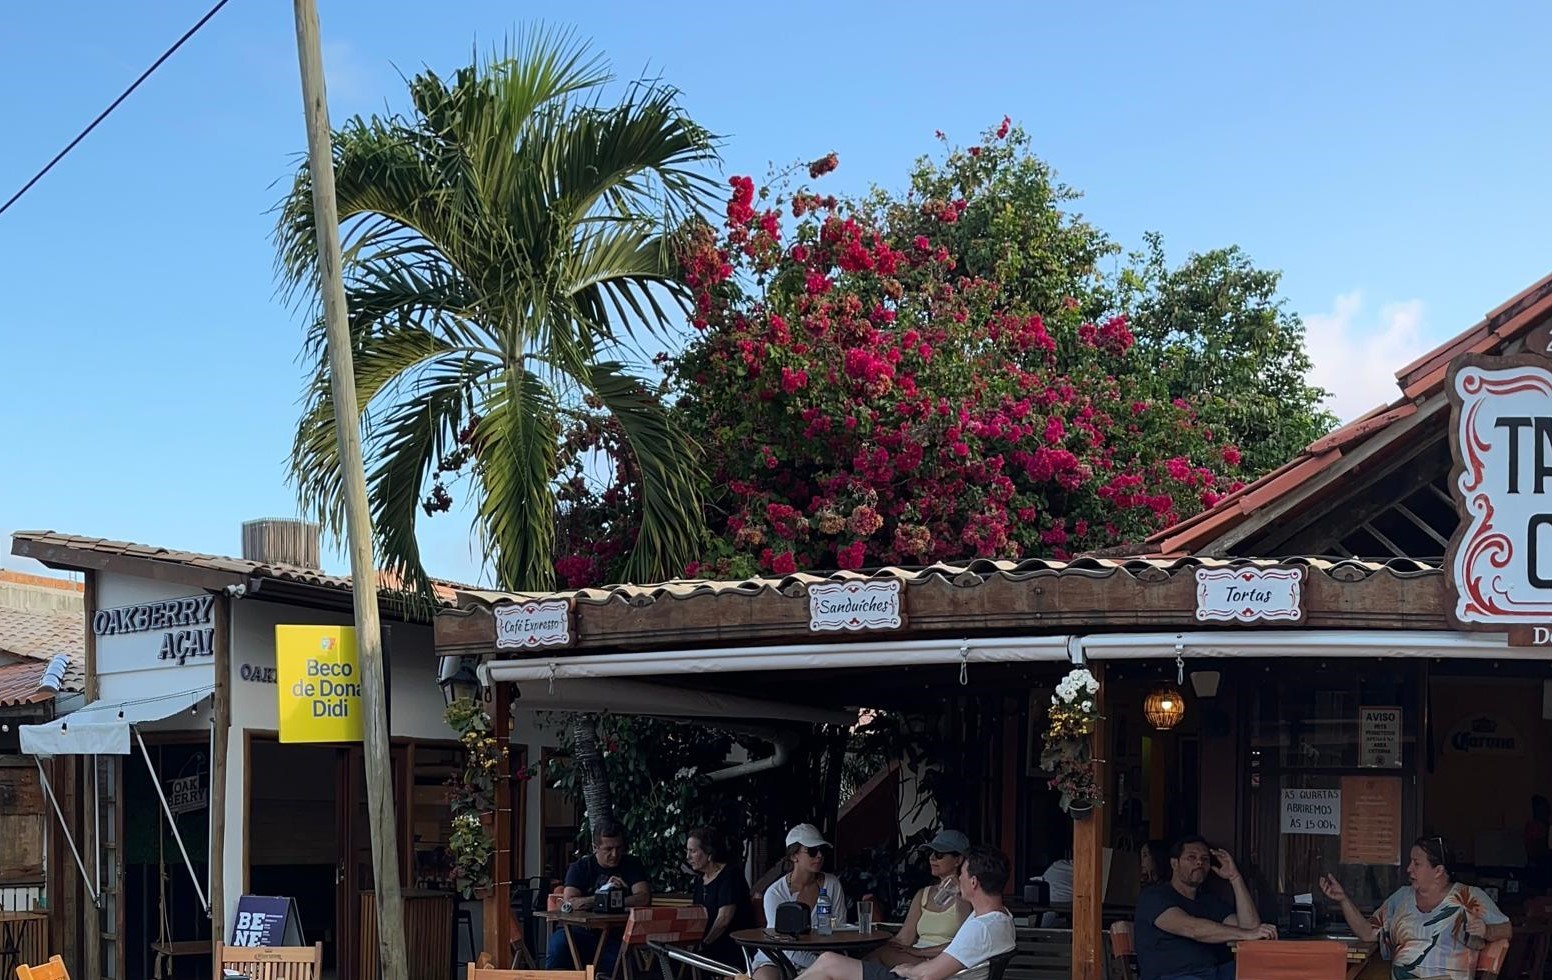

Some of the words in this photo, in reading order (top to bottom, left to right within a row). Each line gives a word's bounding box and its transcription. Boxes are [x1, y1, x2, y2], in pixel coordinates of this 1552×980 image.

[1226, 586, 1273, 603] Tortas
[93, 595, 215, 635] OAKBERRY
[504, 618, 523, 634] Café
[524, 618, 559, 634] Expresso
[306, 659, 352, 677] Beco
[292, 679, 315, 697] de
[313, 700, 349, 717] Didi
[1366, 713, 1396, 721] AVISO
[174, 780, 197, 793] OAK
[1300, 790, 1339, 799] QUARTAS
[1287, 802, 1332, 815] ABRIREMOS
[237, 911, 266, 930] BE
